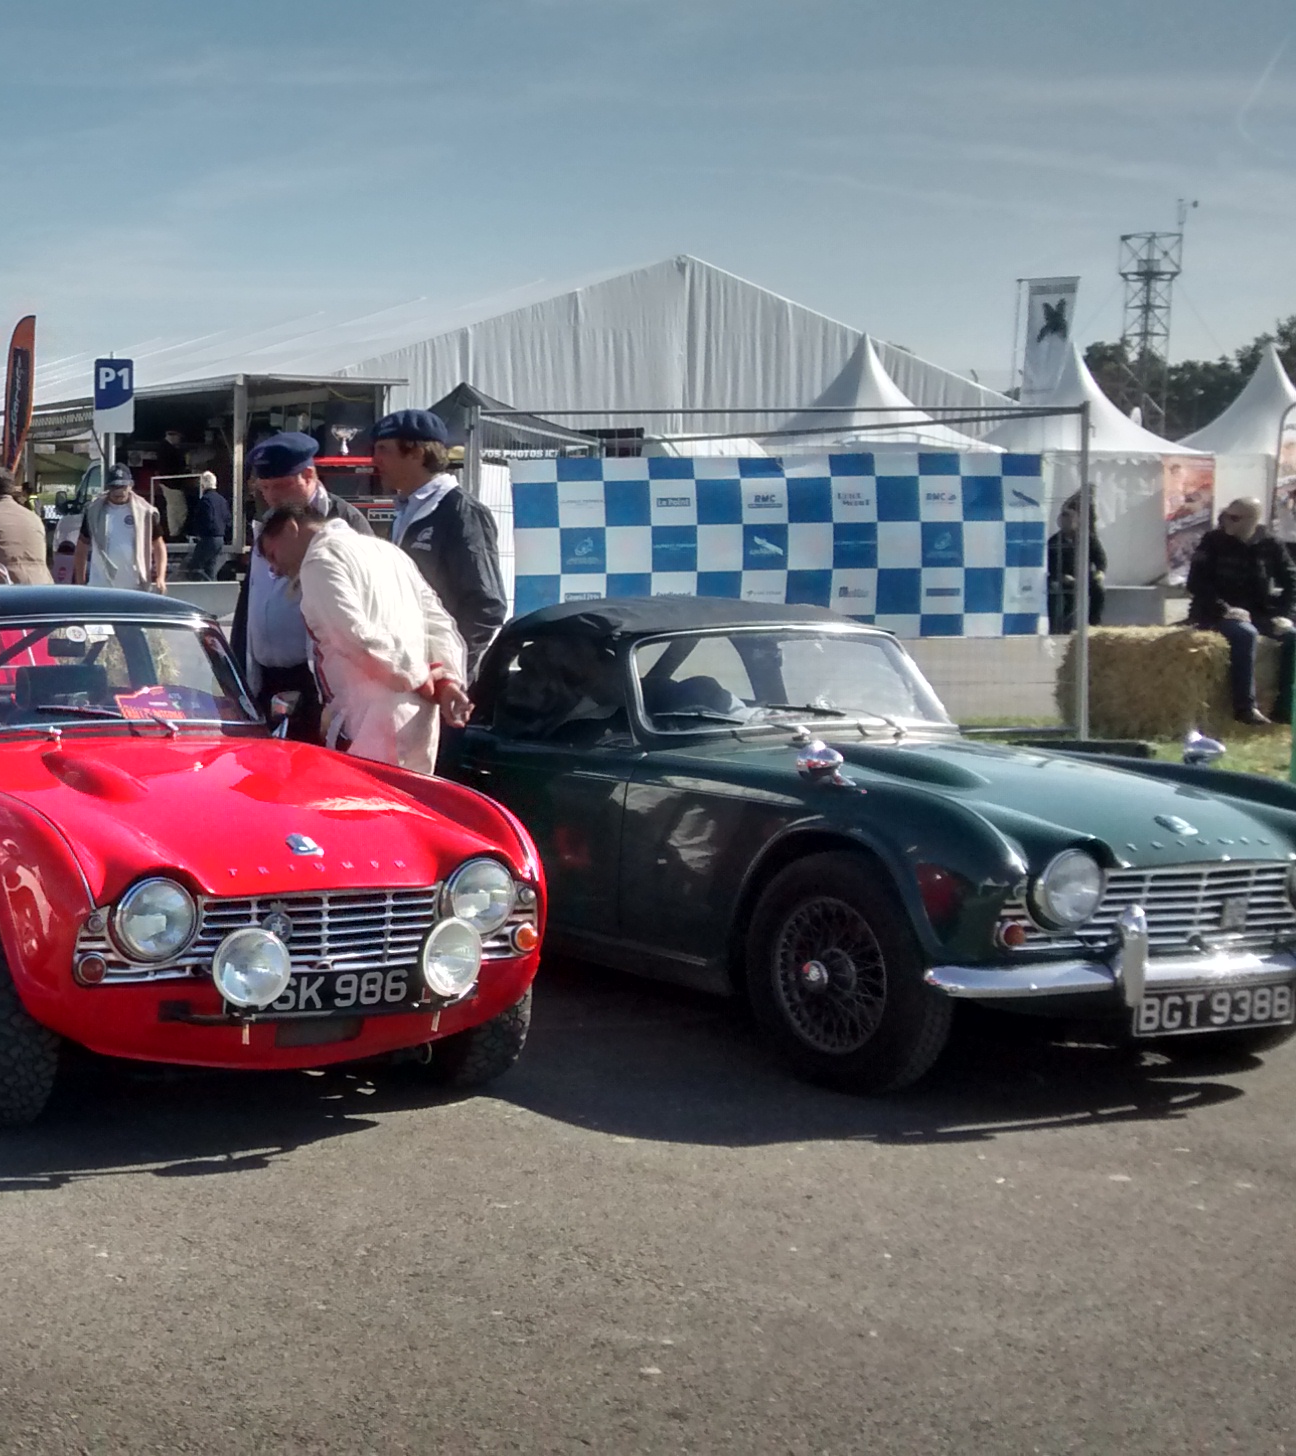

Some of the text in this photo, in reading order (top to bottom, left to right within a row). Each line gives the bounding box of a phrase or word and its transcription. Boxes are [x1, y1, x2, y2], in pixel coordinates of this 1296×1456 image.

[99, 367, 129, 390] P1
[503, 449, 543, 458] PHOTOS
[754, 494, 776, 503] RMC
[257, 969, 409, 1011] SK 986
[1139, 985, 1292, 1031] BGT 938B
